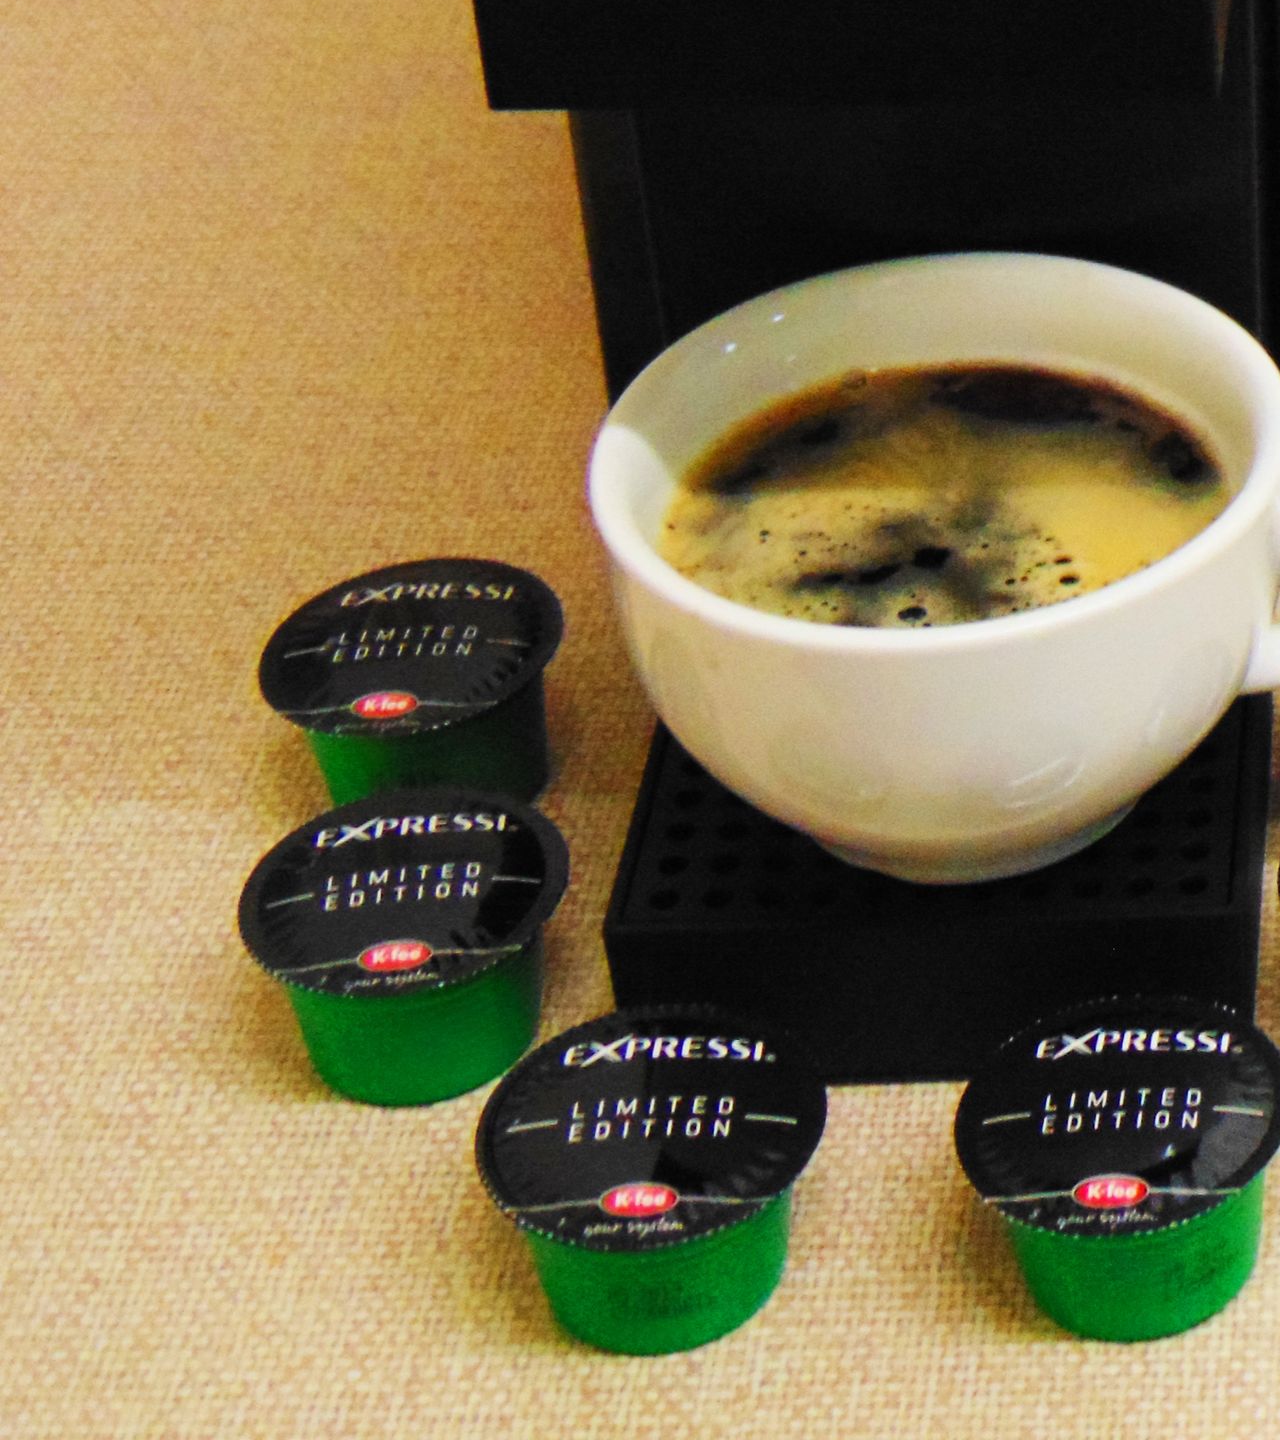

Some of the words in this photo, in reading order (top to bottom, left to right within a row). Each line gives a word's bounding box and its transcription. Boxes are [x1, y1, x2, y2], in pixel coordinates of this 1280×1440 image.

[337, 624, 479, 646] LIMITED
[332, 642, 475, 664] EDITION
[316, 813, 508, 849] EXPRESSI
[326, 861, 482, 893] LIMITED
[324, 880, 480, 912] EDITION
[562, 1032, 768, 1069] EXPRESSI
[1035, 1027, 1233, 1060] EXPRESSI
[571, 1094, 736, 1120] LIMITED
[1045, 1087, 1203, 1112] LIMITED
[567, 1118, 733, 1144] EDITION
[1041, 1111, 1200, 1135] EDITION
